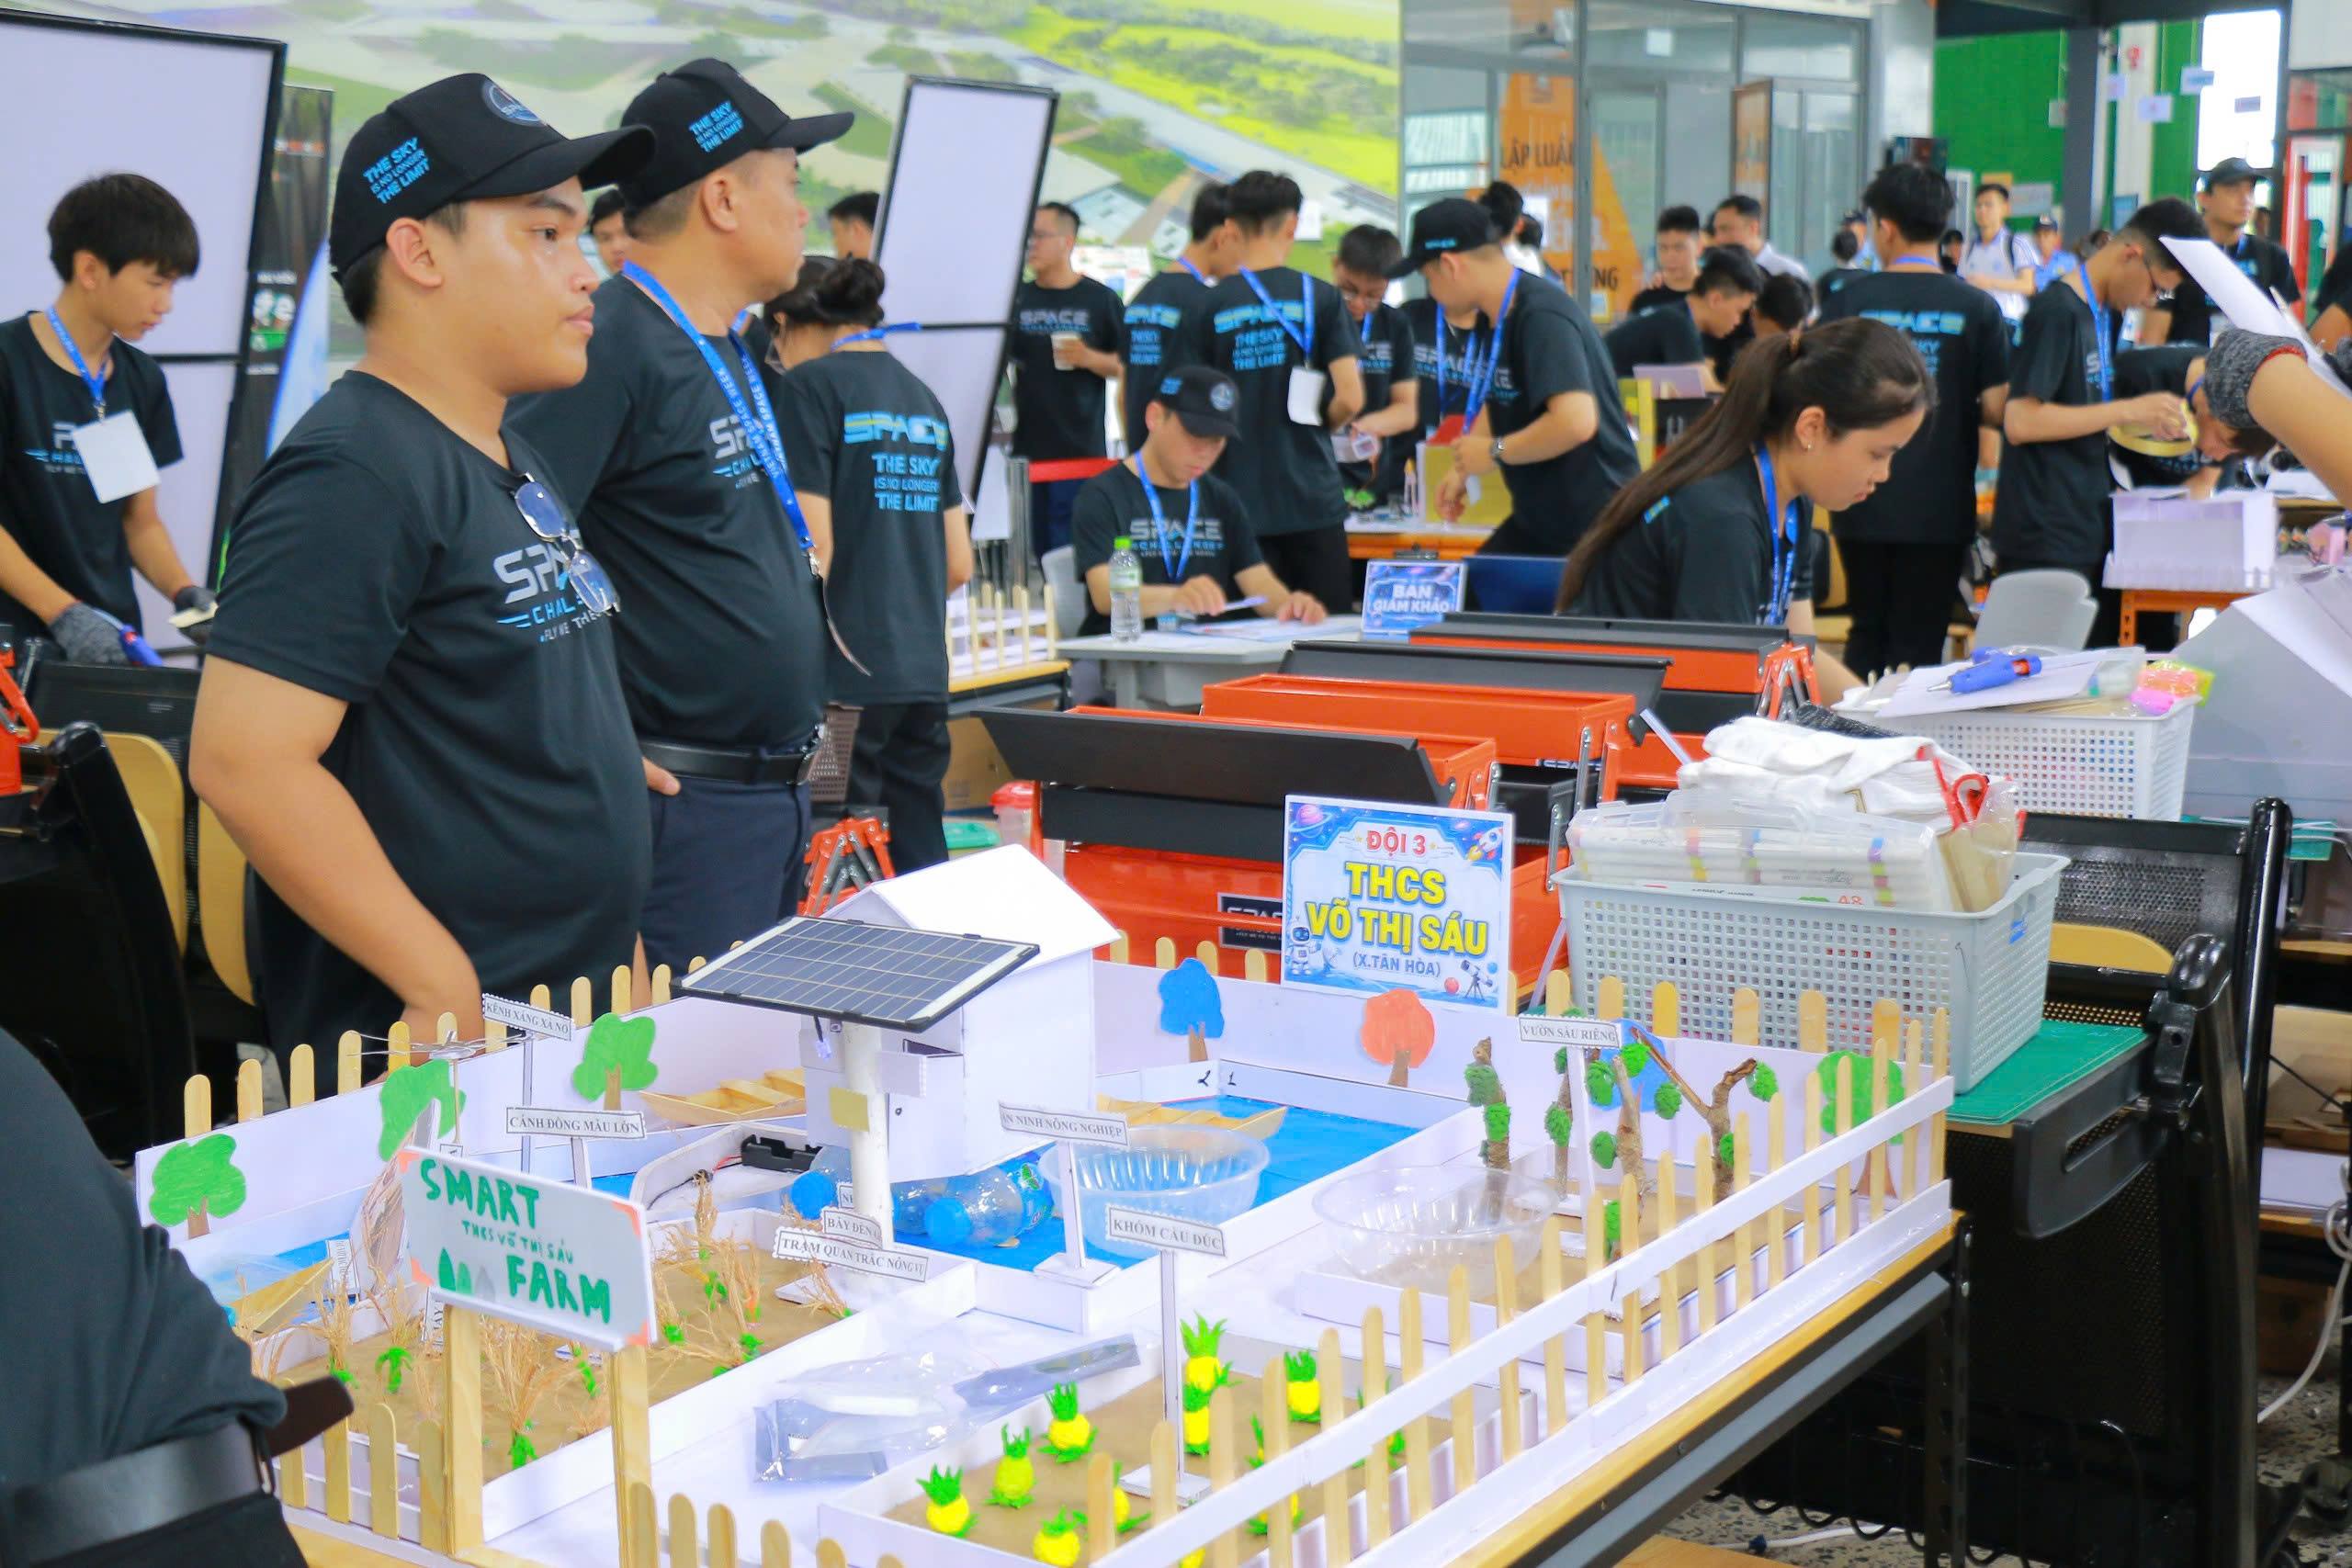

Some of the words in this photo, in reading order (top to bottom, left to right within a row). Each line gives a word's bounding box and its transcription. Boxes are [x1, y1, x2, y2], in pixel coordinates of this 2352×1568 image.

[363, 156, 392, 183] THE
[390, 137, 418, 164] SKY
[370, 182, 381, 195] IS
[379, 173, 393, 188] NO
[392, 148, 425, 177] LONGER
[377, 182, 402, 204] THE
[399, 158, 430, 187] LIMIT
[1020, 310, 1090, 325] SPACE
[715, 366, 738, 399] WEEK
[732, 398, 756, 433] SPACE
[750, 383, 771, 422] SPACE
[871, 453, 907, 475] THE
[909, 456, 942, 477] SKY
[901, 478, 939, 493] LONGER
[875, 492, 902, 511] THE
[904, 494, 939, 513] LIMIT
[1393, 584, 1431, 600] BAN
[1366, 826, 1407, 856] ĐỘI
[1413, 835, 1426, 854] 3
[1345, 862, 1447, 907] THCS
[1306, 897, 1352, 940] VÕ
[1359, 908, 1413, 955] THỊ
[1419, 910, 1488, 956] SÁU
[486, 1001, 511, 1017] KÊNH
[556, 1022, 569, 1034] NO
[1581, 1027, 1616, 1042] RIÊNG
[1016, 1115, 1044, 1128] NINH
[1046, 1117, 1078, 1133] NÔNG
[1080, 1123, 1123, 1138] NGHIỆP
[420, 1158, 539, 1229] SMART
[782, 1237, 820, 1254] TRẠM
[823, 1245, 853, 1259] QUAN
[506, 1255, 611, 1324] FARM
